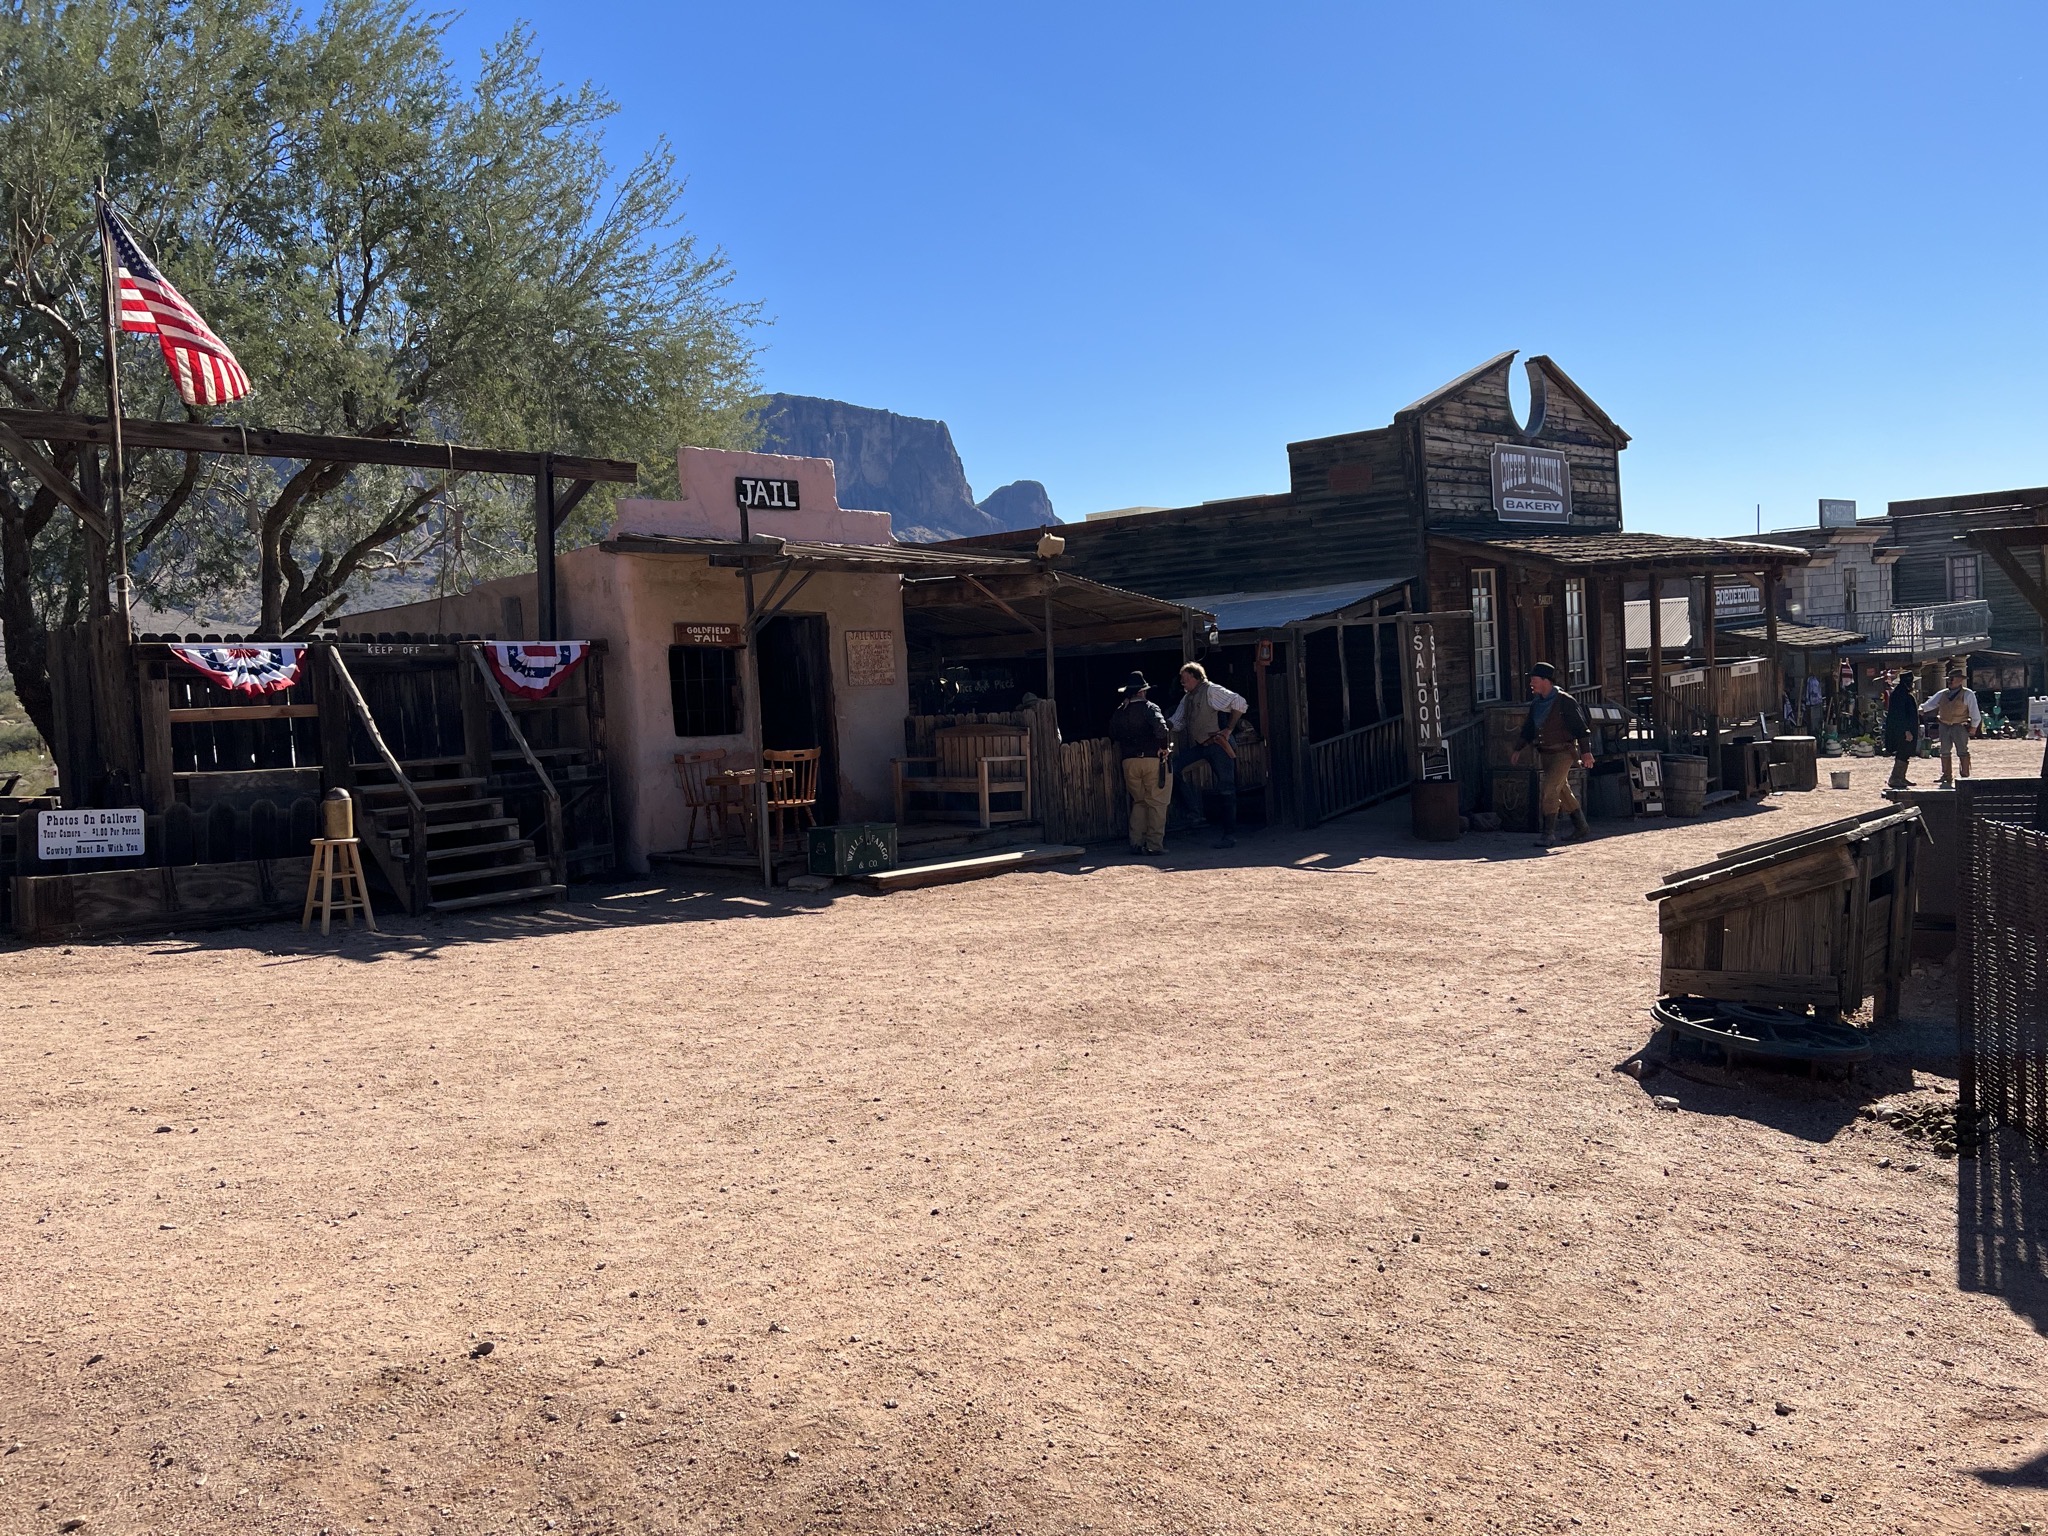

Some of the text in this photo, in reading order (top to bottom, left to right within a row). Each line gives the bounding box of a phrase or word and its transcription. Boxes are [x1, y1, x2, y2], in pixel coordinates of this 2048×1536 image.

[1500, 452, 1563, 497] COFFEE CANTINA
[739, 479, 797, 507] JAIL
[1505, 500, 1560, 511] BAKERY
[1715, 587, 1760, 605] BORDERTOWN
[686, 626, 731, 635] GOLDFIELD
[849, 631, 892, 640] JAIL RULES
[694, 634, 722, 643] JAIL
[367, 645, 420, 654] KEEP OFF
[1413, 634, 1430, 739] SALOON
[1430, 634, 1443, 738] SALOON
[47, 813, 137, 826] Photos On Gallows
[43, 830, 57, 838] Your
[59, 829, 81, 838] Camera
[110, 827, 119, 836] Per
[122, 827, 140, 836] Person
[46, 843, 138, 856] Cowboy Must Be With You
[847, 834, 889, 862] WELLS FARGO
